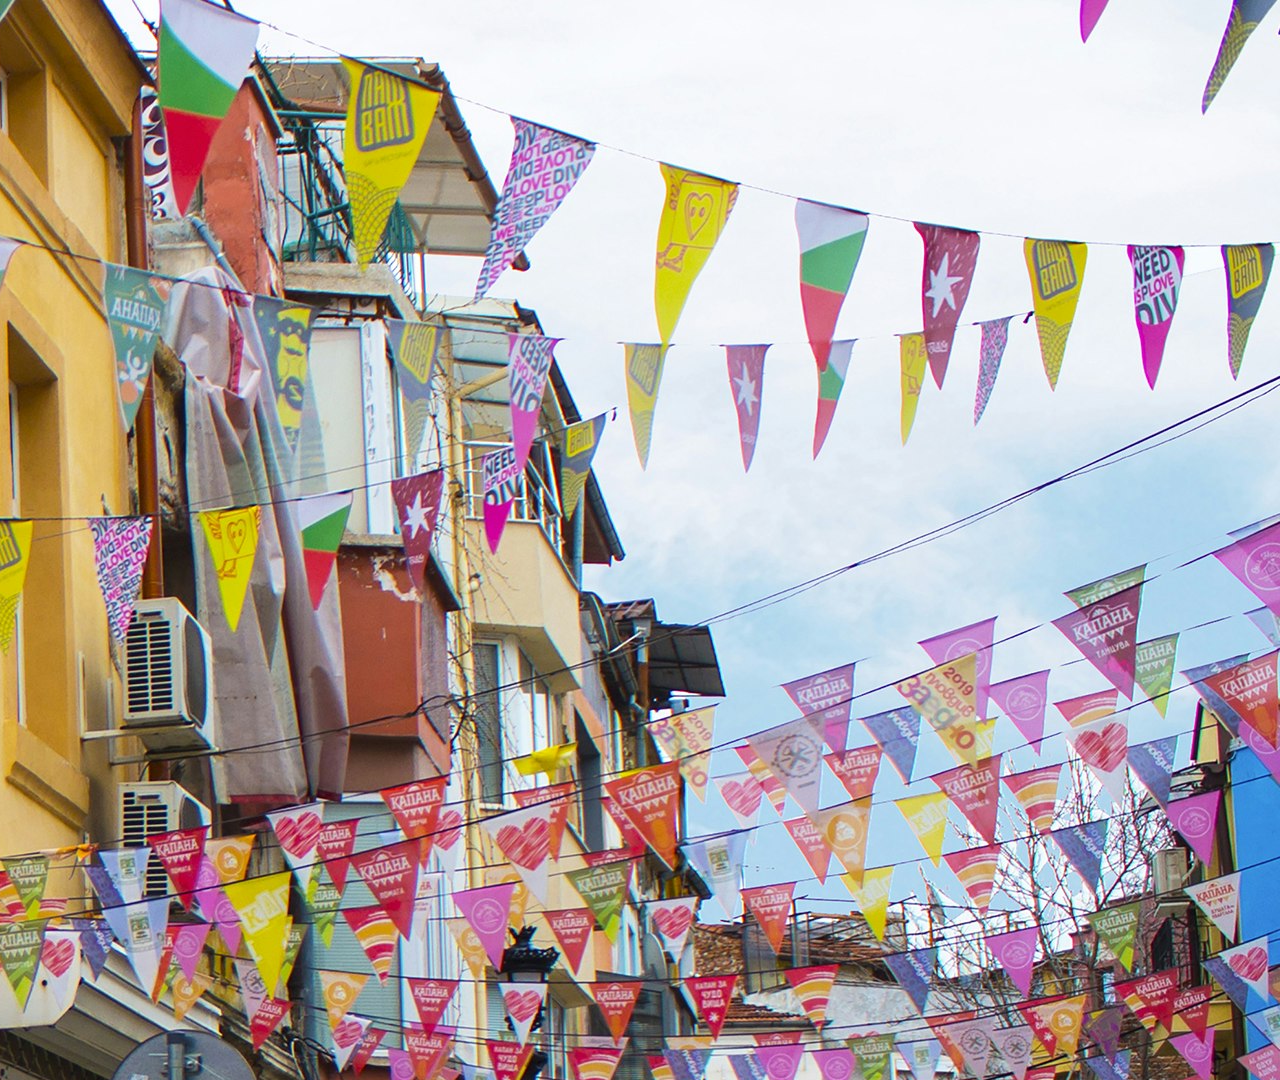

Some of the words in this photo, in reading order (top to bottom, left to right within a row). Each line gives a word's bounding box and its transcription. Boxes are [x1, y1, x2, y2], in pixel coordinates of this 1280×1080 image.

[1073, 605, 1135, 643] КАПАНА
[797, 677, 850, 705] КАПАНА
[943, 667, 973, 696] 2019
[1220, 665, 1278, 698] КАПАНА
[619, 775, 678, 804] КАПАНА
[944, 770, 994, 797] КАПАНА
[391, 787, 440, 811] КАПАНА
[155, 838, 199, 857] КАПАНА
[10, 863, 46, 879] КАПАНА
[359, 856, 411, 883] КАПАНА
[578, 873, 624, 891] КАПАНА
[750, 893, 790, 906] КАПАНА
[1196, 884, 1235, 901] КАПАНА
[553, 917, 589, 930] КАПАНА
[1095, 910, 1136, 931] КАПАНА
[414, 986, 449, 999] КАПАНА
[1136, 977, 1172, 993] КАПАНА
[596, 990, 634, 1003] КАПАНА
[854, 1041, 890, 1053] КАПАНА
